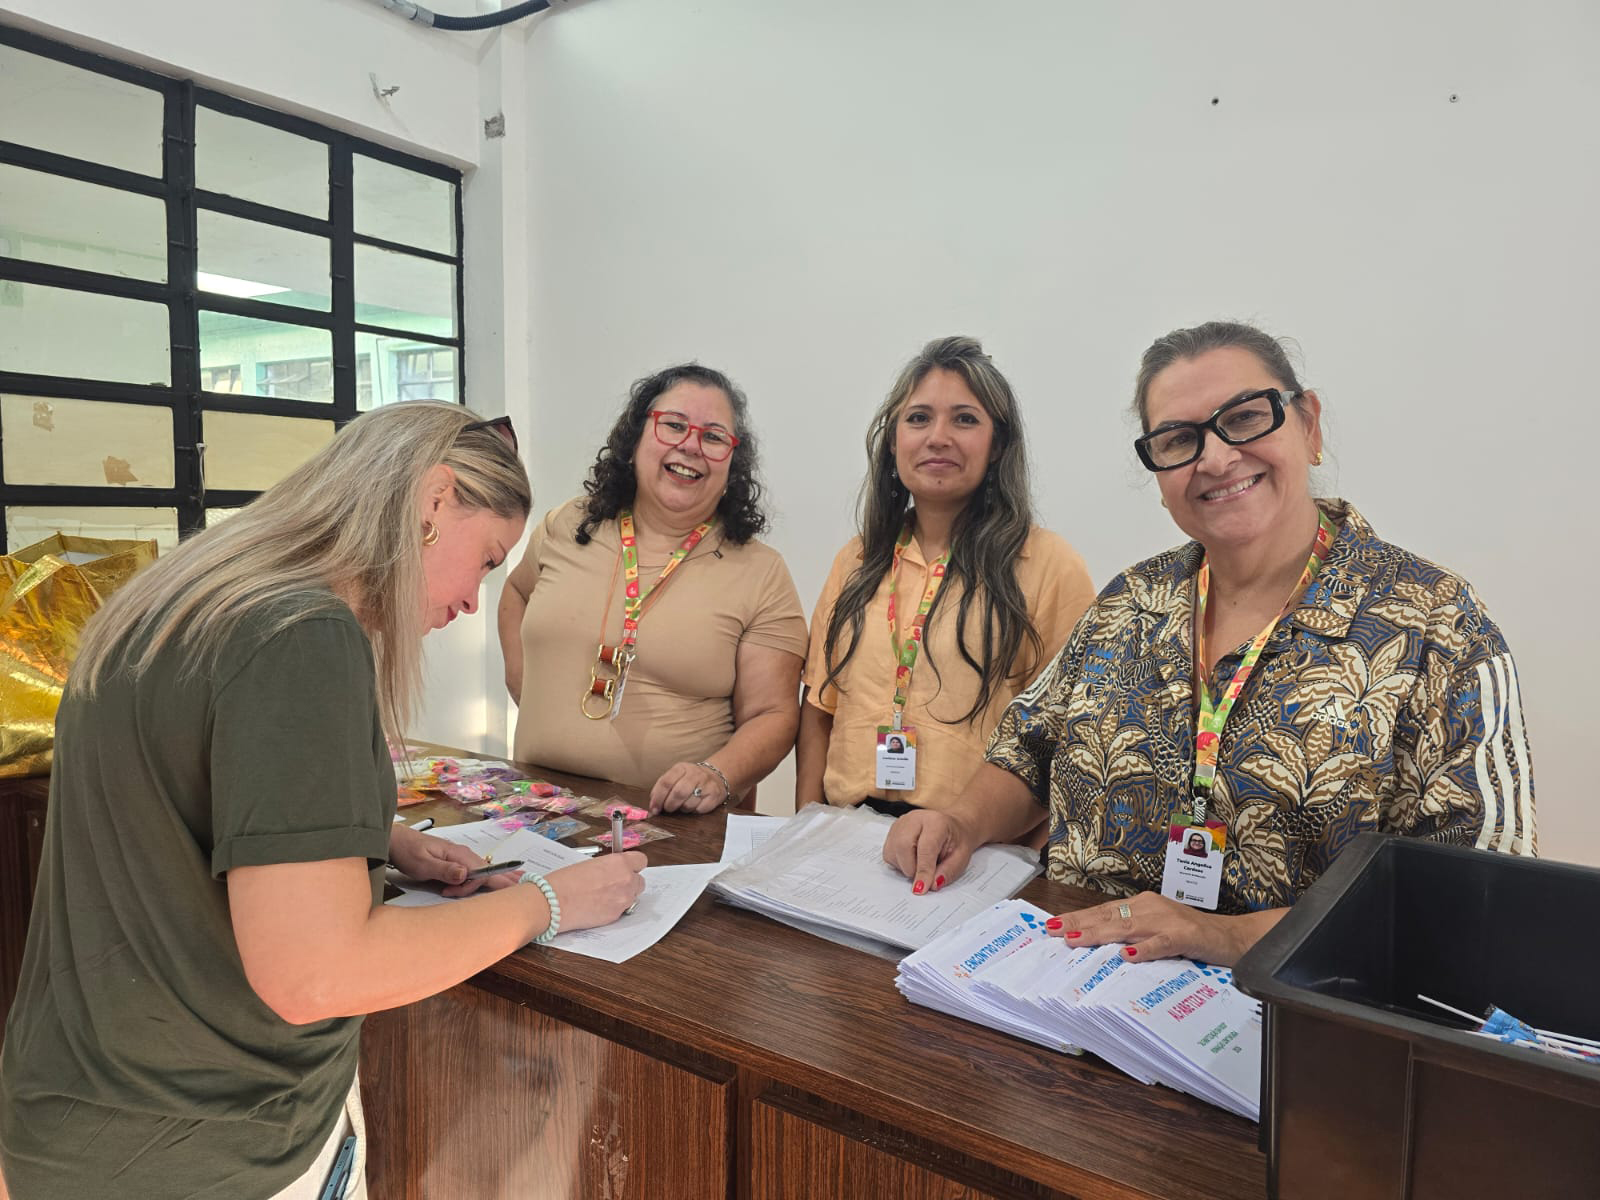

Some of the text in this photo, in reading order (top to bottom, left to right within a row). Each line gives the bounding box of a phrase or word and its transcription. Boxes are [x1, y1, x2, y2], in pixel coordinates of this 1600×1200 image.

[1311, 711, 1351, 729] adidas
[964, 943, 999, 970] ENCONTRO
[991, 924, 1026, 950] FORMATIVO
[1084, 966, 1114, 992] ENCONTRO
[1140, 984, 1175, 1008] ENCONTRO
[1165, 969, 1201, 993] FORMATIVO
